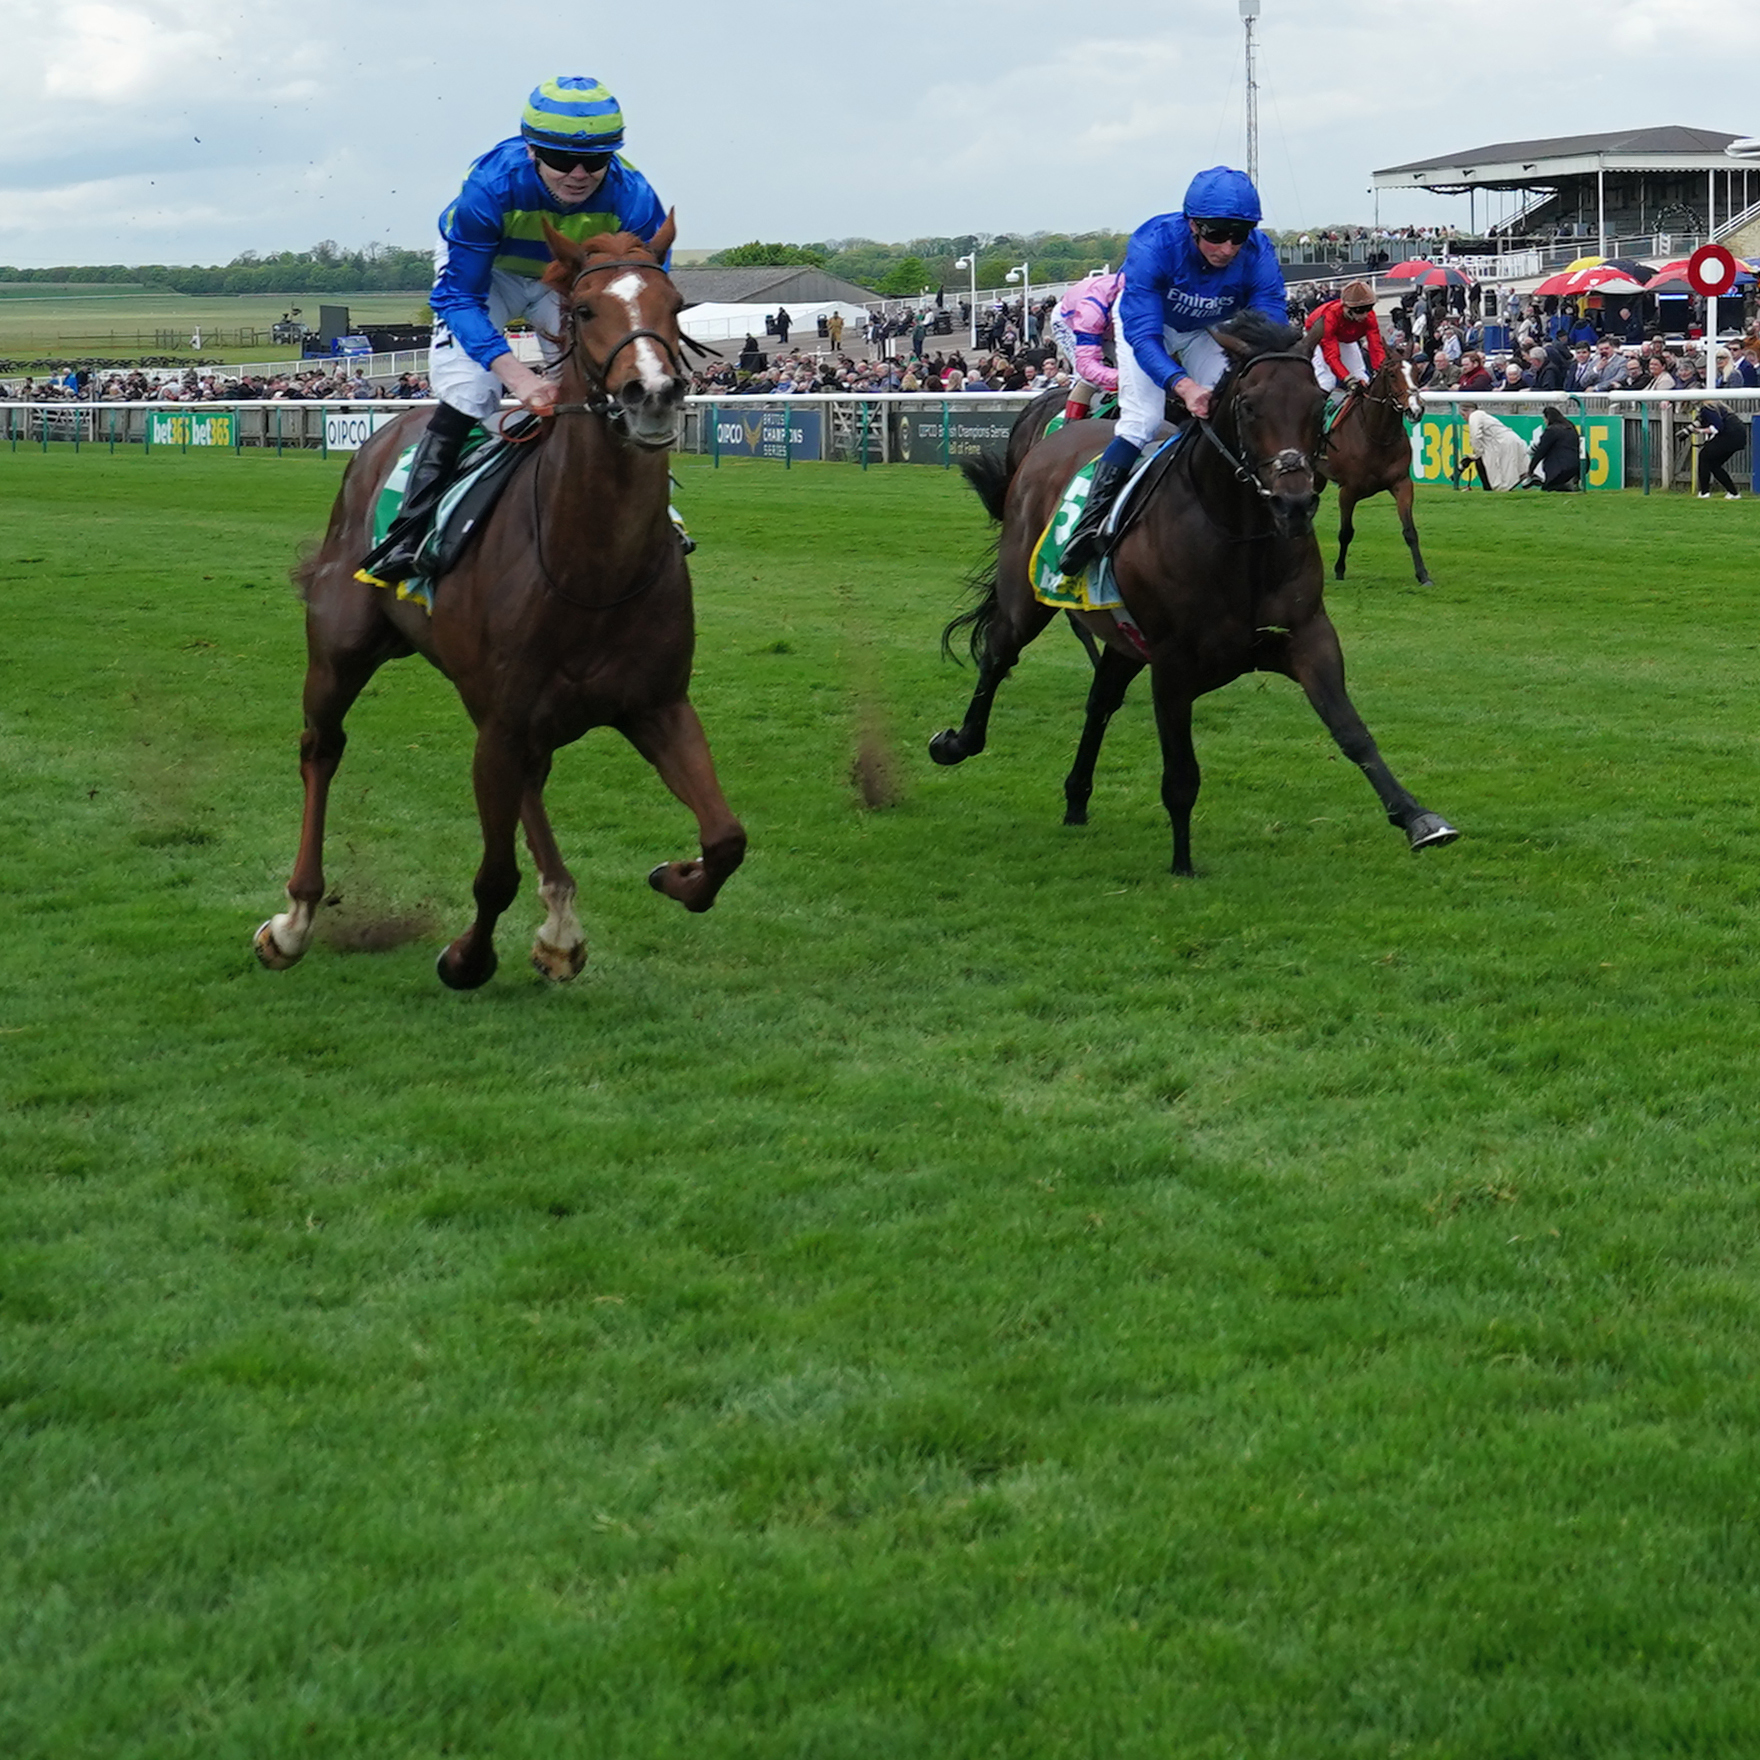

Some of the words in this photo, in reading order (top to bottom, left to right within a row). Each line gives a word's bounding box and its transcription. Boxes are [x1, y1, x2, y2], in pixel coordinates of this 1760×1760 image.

[1167, 287, 1235, 309] Emirates
[192, 416, 230, 446] bet365
[328, 420, 367, 445] QIPCO
[763, 428, 803, 444] CHAMPONS
[1055, 475, 1091, 546] 5
